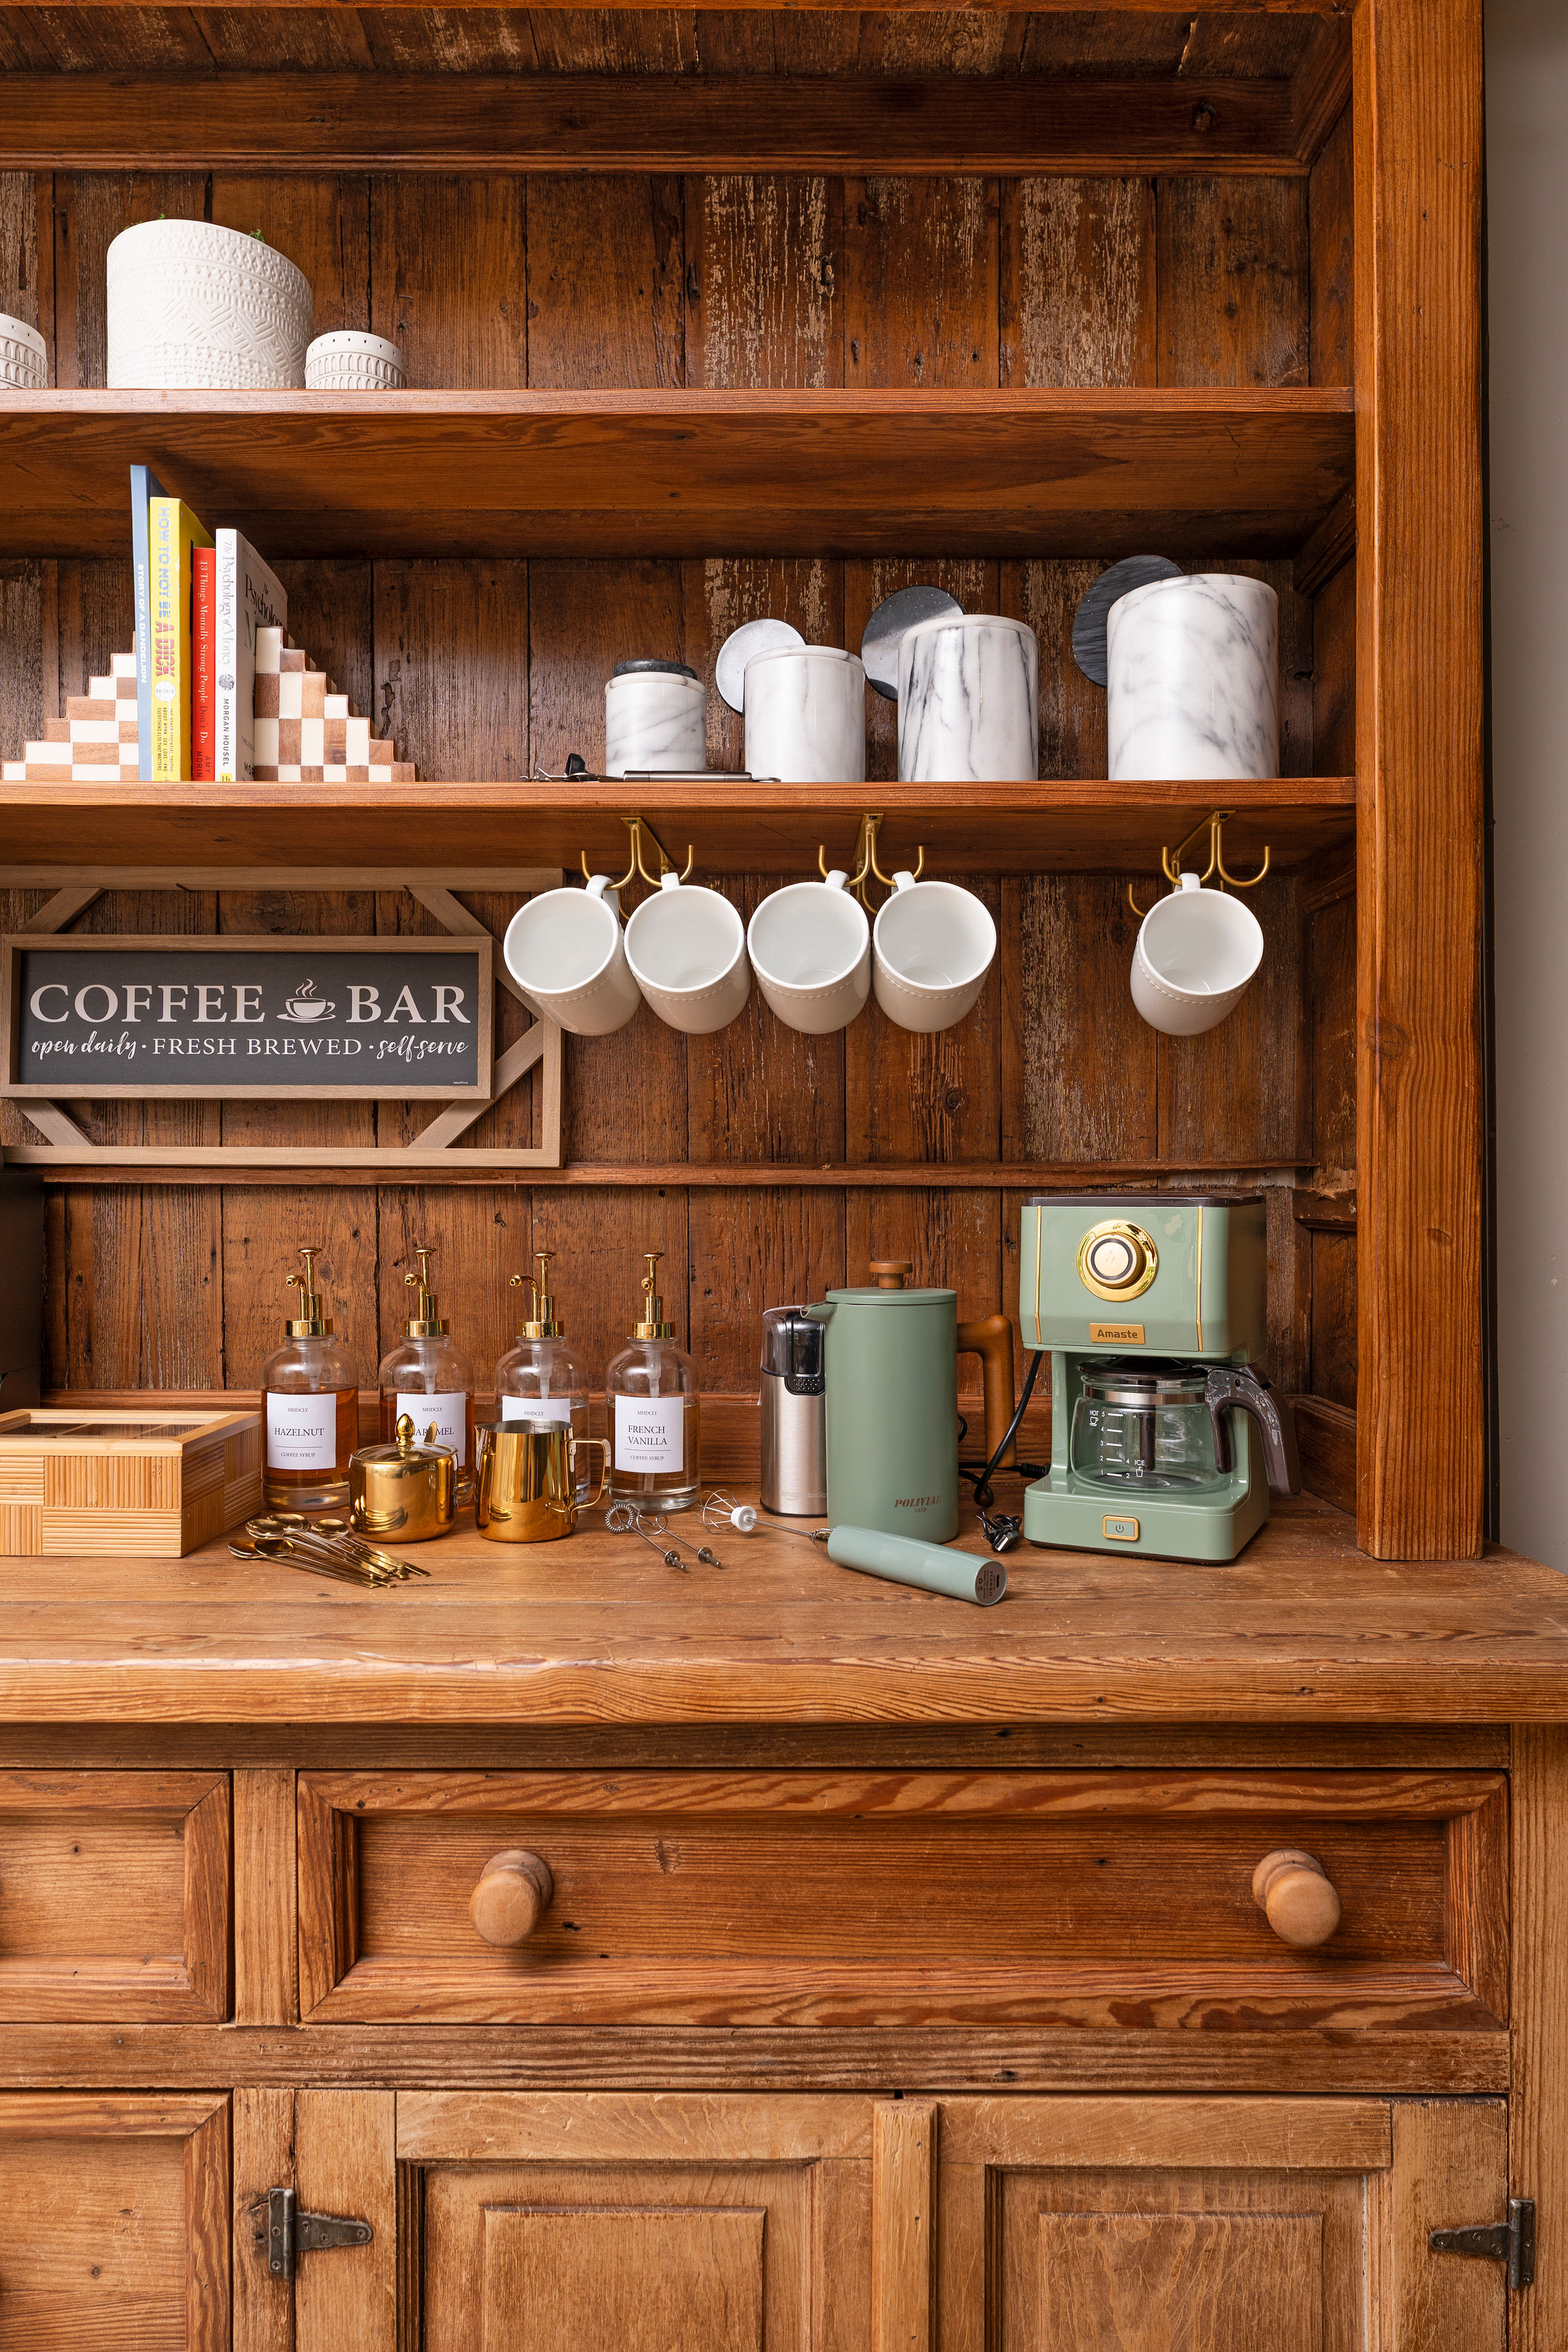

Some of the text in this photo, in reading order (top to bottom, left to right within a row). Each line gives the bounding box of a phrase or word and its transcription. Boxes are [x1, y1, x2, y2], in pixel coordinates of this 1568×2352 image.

[155, 507, 175, 677] HOW TO NOT BE A DICK
[220, 557, 235, 617] Psychology
[139, 598, 145, 609] OF
[223, 619, 232, 627] of
[198, 561, 208, 743] 13 Things Mentally Strong People Don't Do
[220, 629, 235, 666] Money
[29, 984, 471, 1024] COFFEE BAR
[31, 1030, 469, 1063] open daily FRESH BREWED self-serve
[1097, 1329, 1138, 1339] Amaste
[274, 1427, 325, 1437] HAZELNUT
[415, 1427, 454, 1436] ARMEL
[628, 1425, 666, 1434] FRENCH
[628, 1436, 667, 1445] VANILLA
